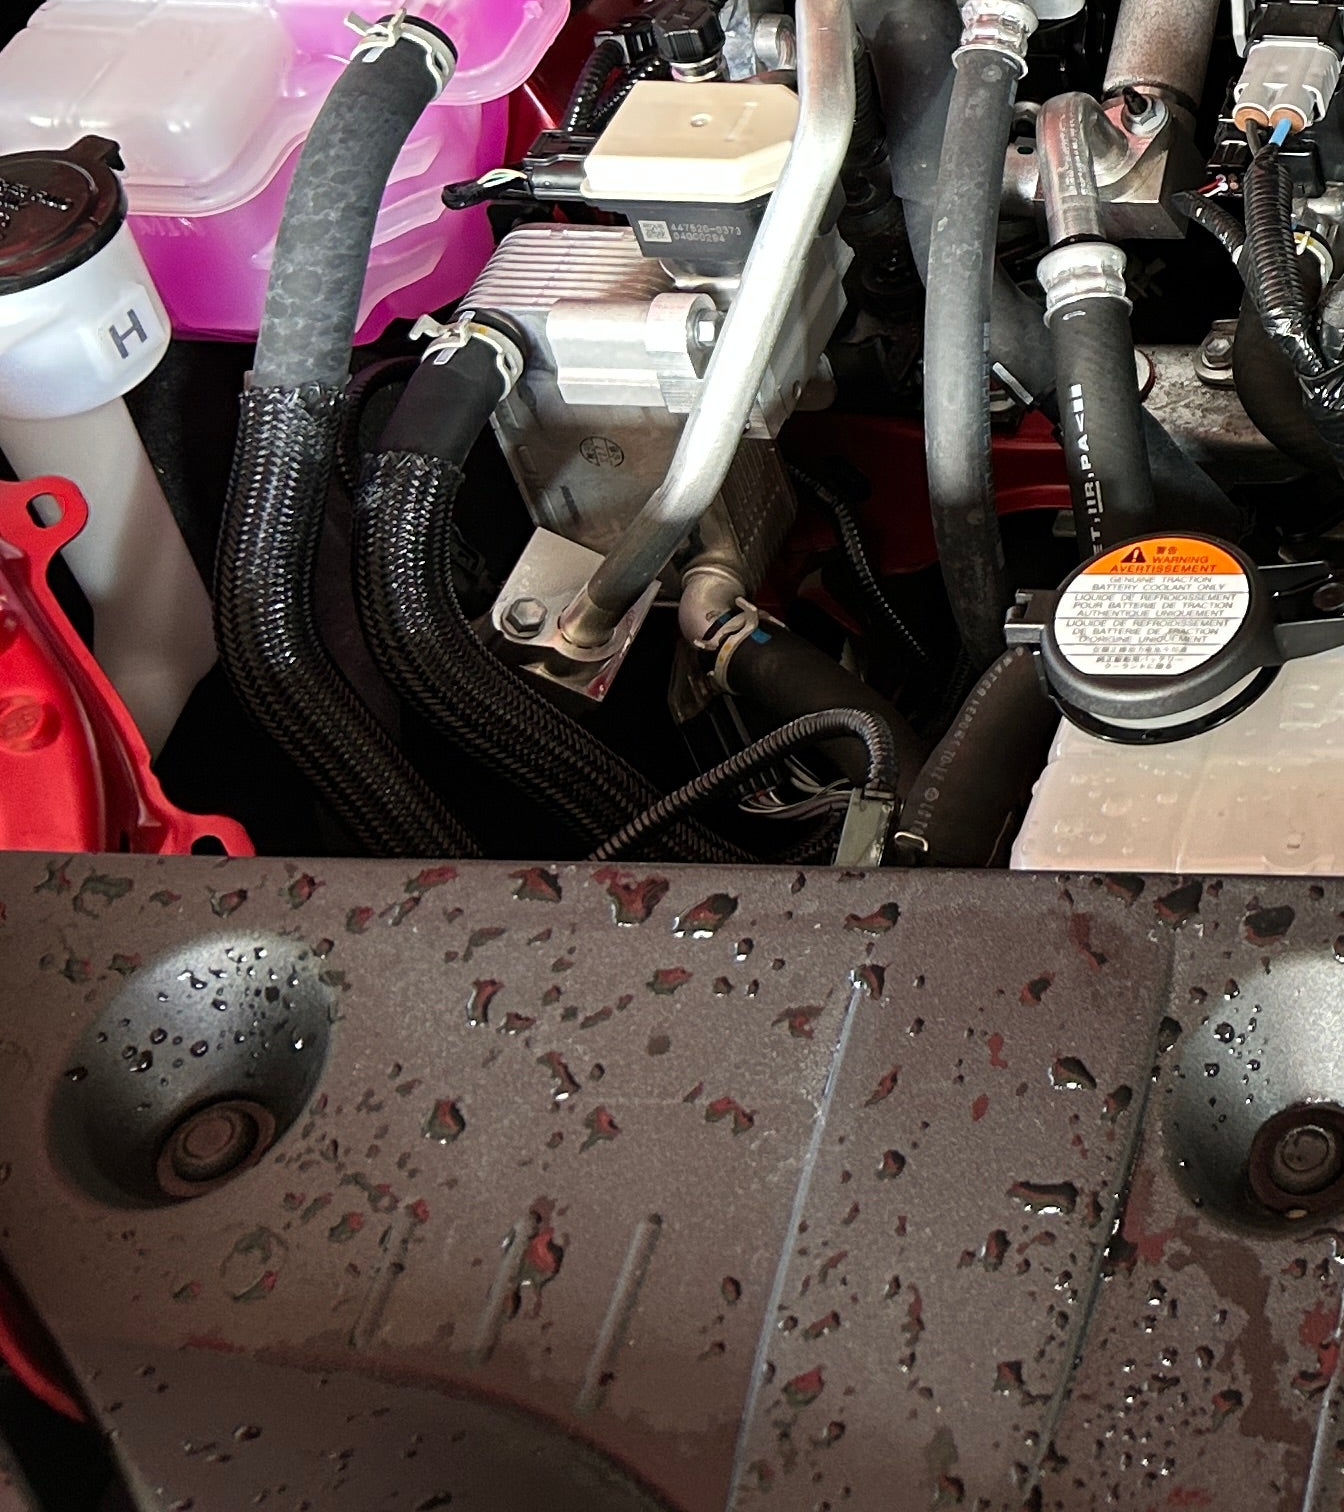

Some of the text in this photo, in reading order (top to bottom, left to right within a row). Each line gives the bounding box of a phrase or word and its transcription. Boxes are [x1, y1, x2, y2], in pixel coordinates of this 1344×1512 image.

[109, 308, 149, 359] H
[1152, 556, 1209, 564] WARNING
[1110, 564, 1217, 573] AVERTISSEMENT
